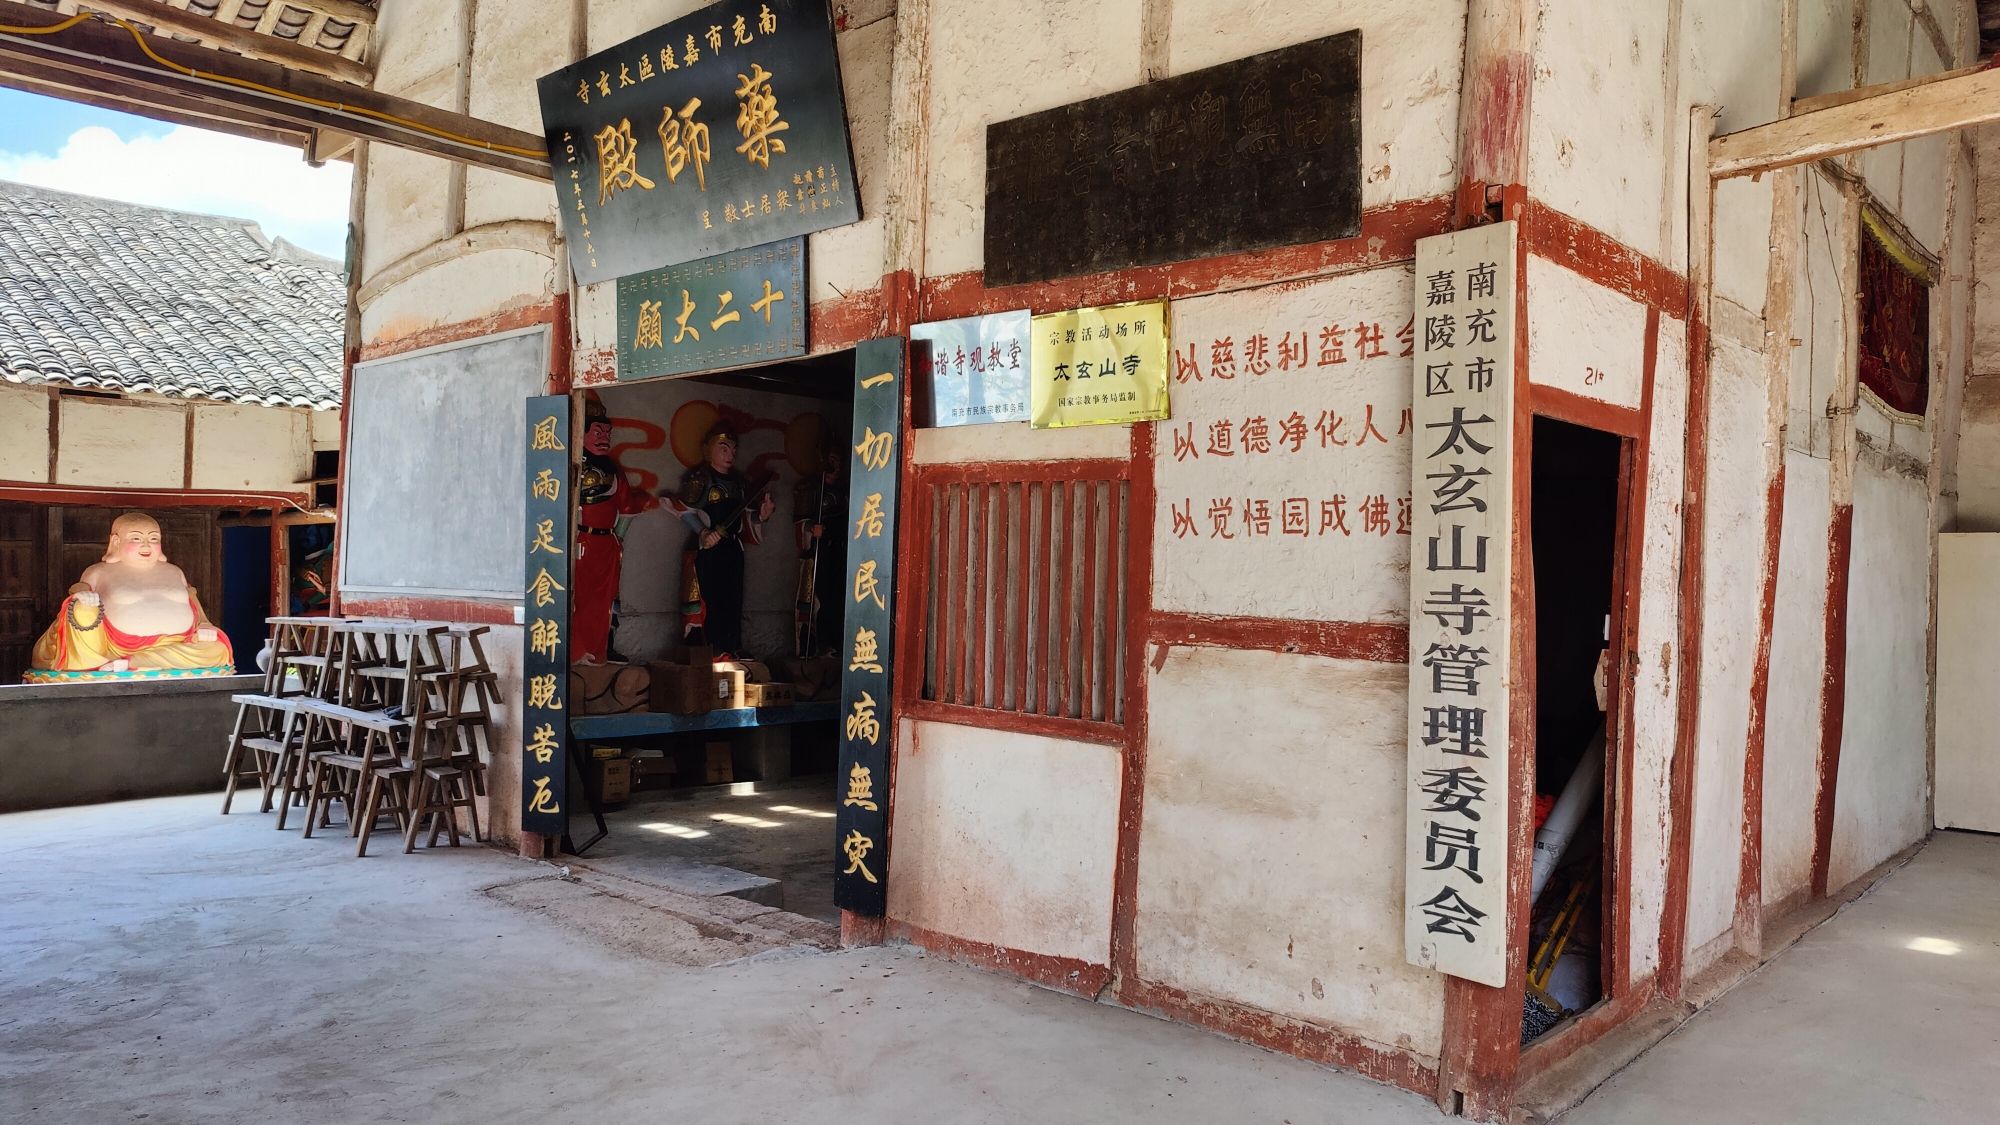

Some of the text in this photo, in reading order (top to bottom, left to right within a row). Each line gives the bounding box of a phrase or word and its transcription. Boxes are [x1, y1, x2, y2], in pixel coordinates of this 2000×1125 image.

[594, 63, 790, 207] 藥師殿
[634, 280, 785, 352] 十二大願
[1049, 320, 1147, 346] 宗教活动场所
[1424, 270, 1457, 398] 嘉陵区
[1465, 261, 1497, 393] 南充市
[917, 338, 1022, 378] 谐寺观教堂
[1053, 354, 1142, 382] 太玄山寺
[951, 402, 1024, 418] 南充市民族宗教事务局
[1058, 391, 1136, 408] 国家宗教事务局监制
[1419, 407, 1496, 944] 太玄山寺管理委员会
